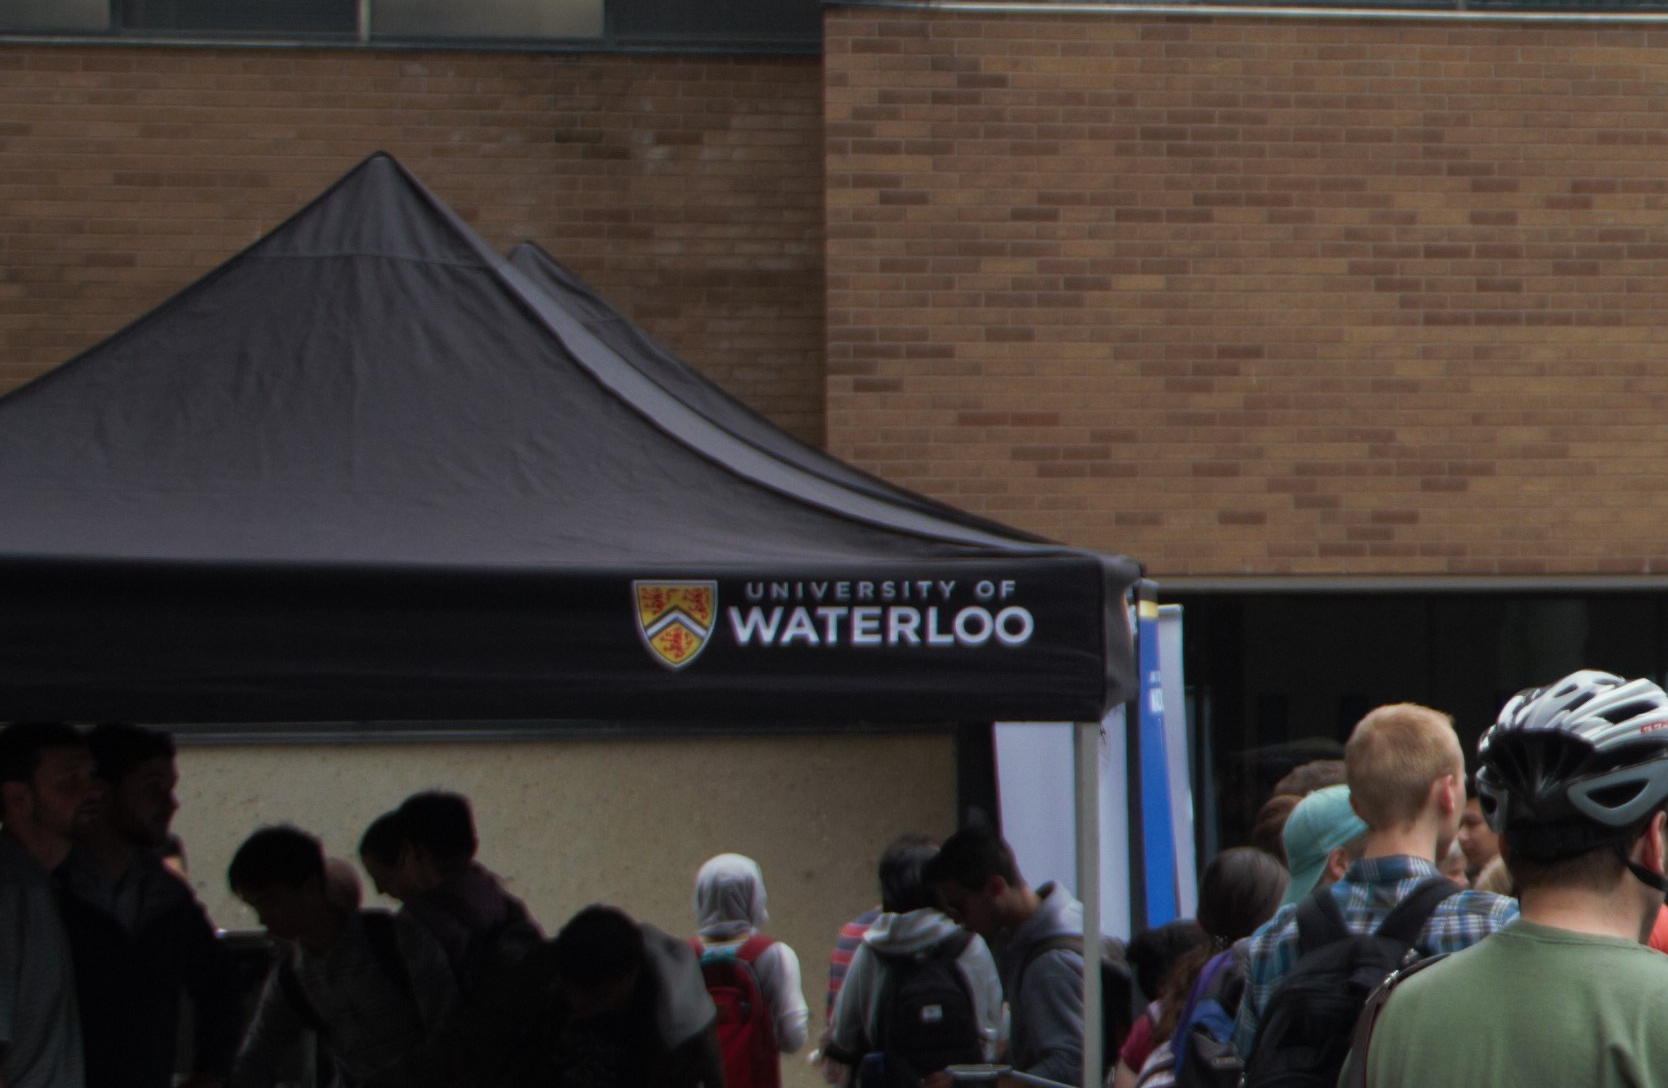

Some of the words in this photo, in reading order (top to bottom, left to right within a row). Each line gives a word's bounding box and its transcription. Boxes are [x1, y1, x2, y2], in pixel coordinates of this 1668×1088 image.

[745, 579, 956, 600] UNIVERSITY
[974, 579, 1016, 599] OF
[727, 604, 1036, 645] WATERLOO
